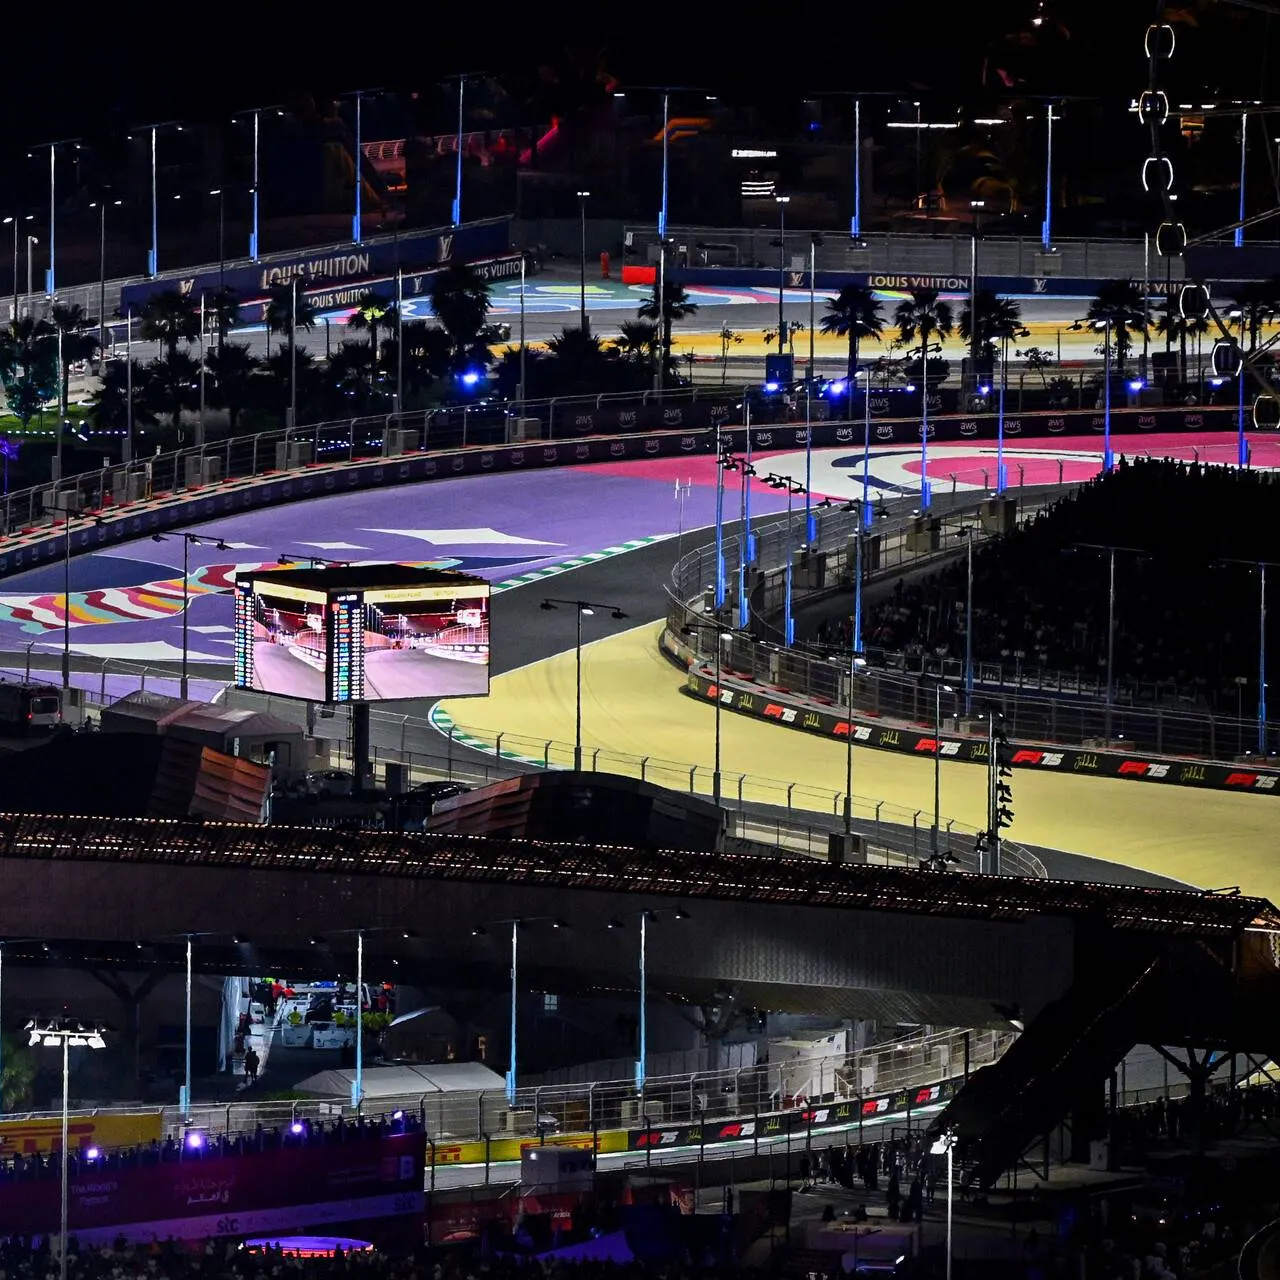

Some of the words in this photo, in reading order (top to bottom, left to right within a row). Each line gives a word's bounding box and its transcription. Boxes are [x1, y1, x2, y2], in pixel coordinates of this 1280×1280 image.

[868, 275, 907, 288] LOUIS
[910, 276, 969, 290] VUITTON
[877, 425, 894, 437] aws
[960, 421, 978, 433] aws
[757, 431, 773, 443] aws
[836, 428, 853, 440] aws
[1039, 752, 1065, 766] 75
[1146, 763, 1171, 779] 75
[216, 1218, 239, 1234] stc
